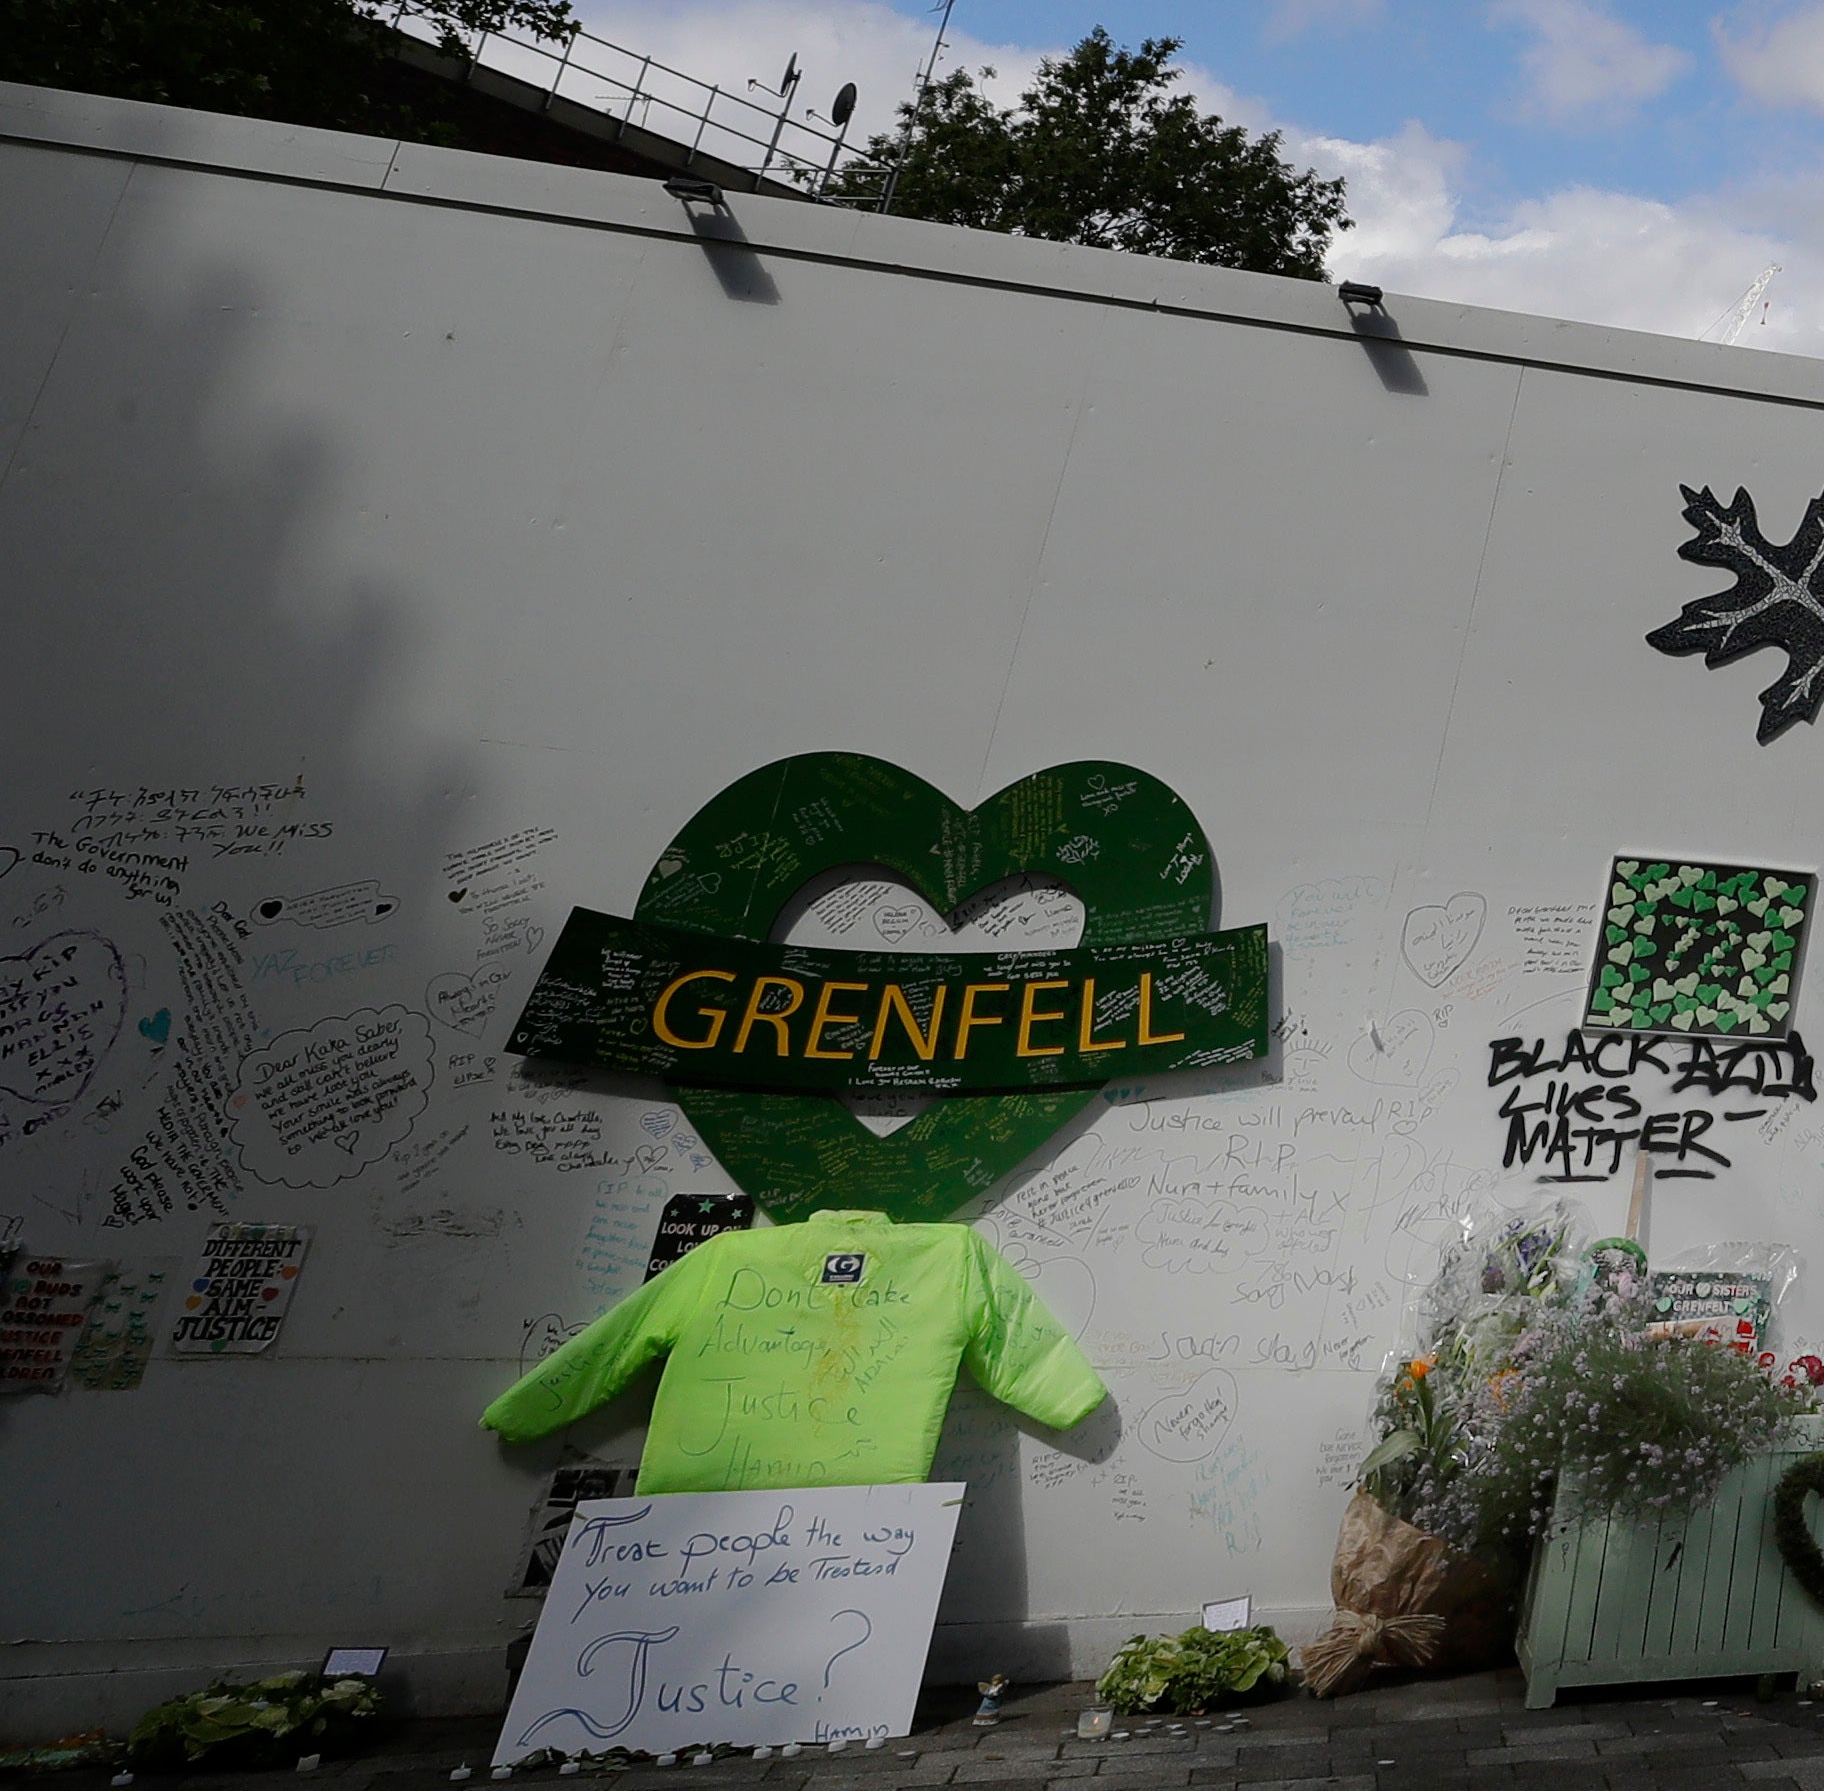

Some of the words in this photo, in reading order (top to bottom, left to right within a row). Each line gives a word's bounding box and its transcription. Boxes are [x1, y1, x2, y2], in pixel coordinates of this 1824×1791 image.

[31, 830, 68, 851] The
[74, 835, 192, 873] Government
[77, 860, 97, 874] do
[105, 864, 182, 896] anything
[652, 968, 1187, 1062] GRENFELL
[253, 1053, 301, 1084] Dear
[303, 1037, 350, 1064] Kaka
[1485, 1028, 1671, 1089] BLACK
[276, 1074, 298, 1090] all
[298, 1063, 329, 1080] miss
[260, 1093, 288, 1110] and
[307, 1099, 342, 1117] smile
[1127, 1100, 1225, 1133] Justice
[1236, 1104, 1283, 1130] will
[1292, 1098, 1388, 1137] prevail
[1499, 1109, 1733, 1177] MATTER
[661, 1222, 696, 1236] LOOK
[700, 1223, 721, 1237] UP
[200, 1239, 303, 1258] DIFFERENT
[25, 1260, 65, 1277] OUR
[32, 1279, 84, 1298] BUDS
[204, 1278, 261, 1298] SAME
[850, 1279, 911, 1307] take
[1668, 1284, 1693, 1296] OUR
[1712, 1283, 1758, 1297] SISTERS
[172, 1315, 285, 1342] JUSTICE
[678, 1375, 863, 1457] Justice
[680, 1504, 790, 1576] people
[805, 1515, 843, 1549] the
[862, 1525, 915, 1557] way
[648, 1570, 719, 1597] want
[727, 1566, 753, 1587] to
[764, 1560, 800, 1586] be
